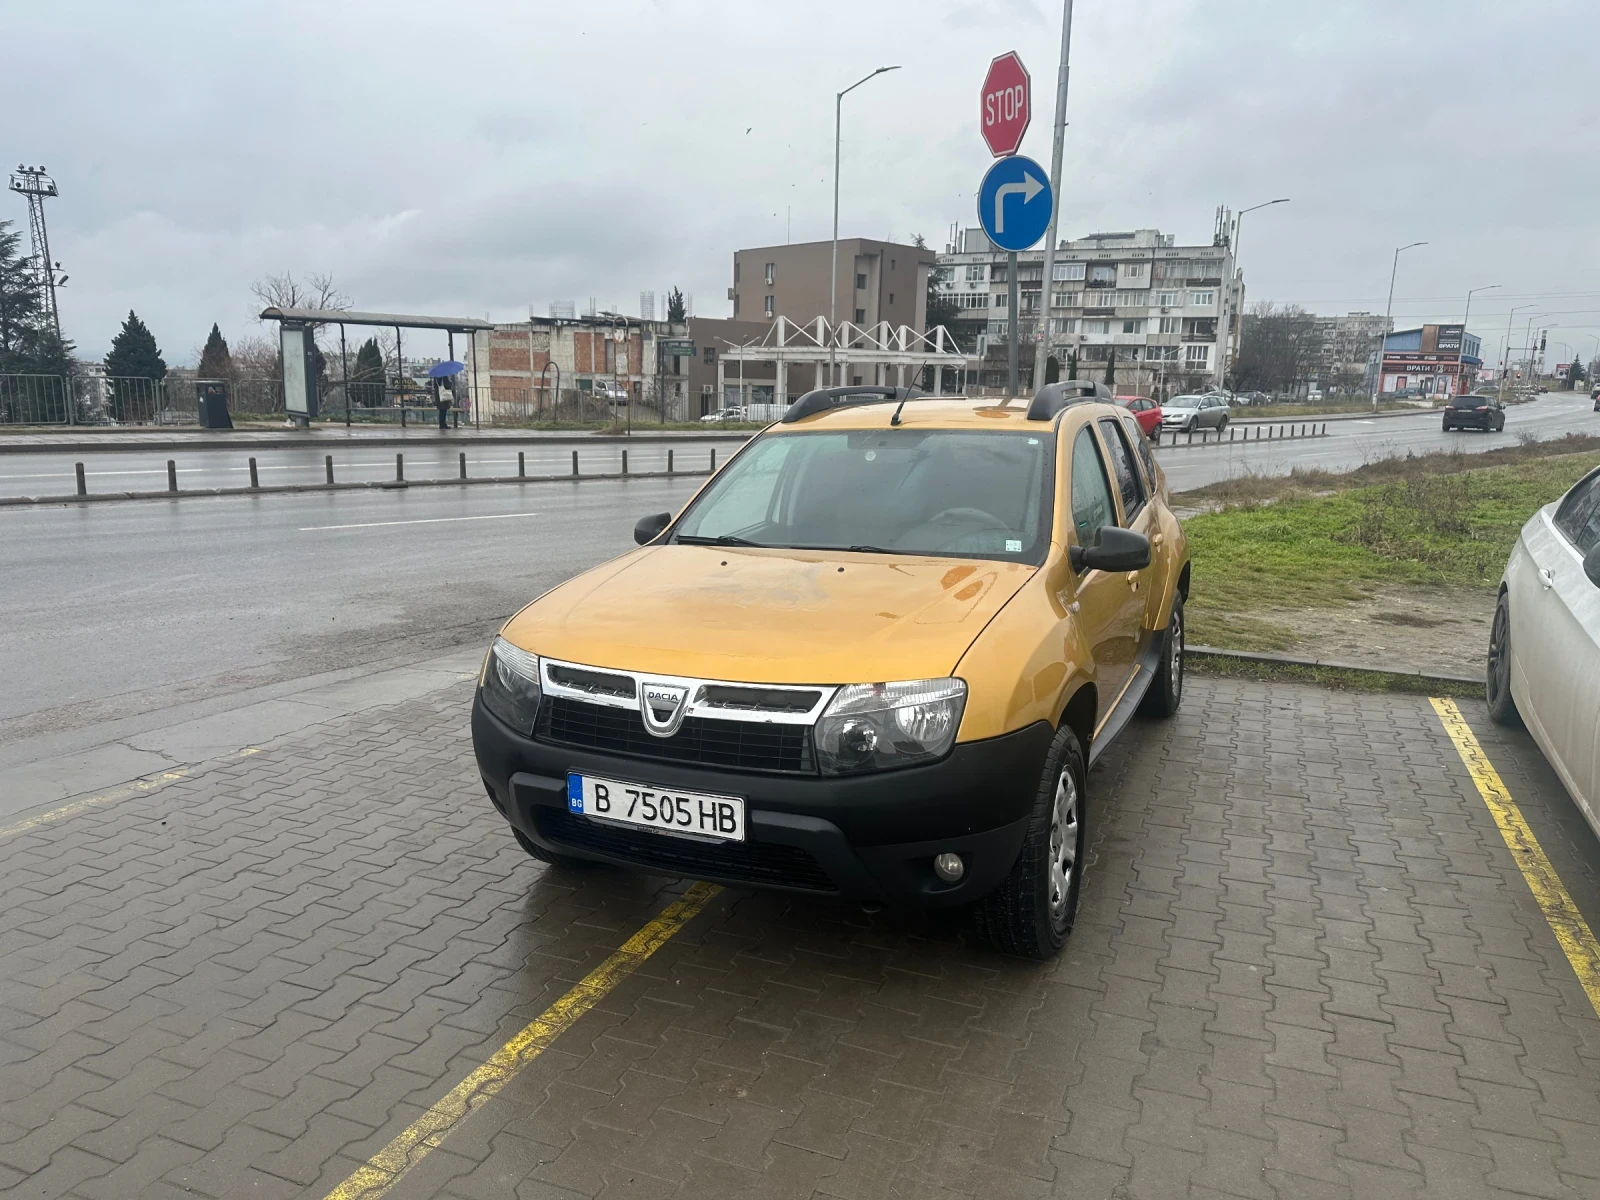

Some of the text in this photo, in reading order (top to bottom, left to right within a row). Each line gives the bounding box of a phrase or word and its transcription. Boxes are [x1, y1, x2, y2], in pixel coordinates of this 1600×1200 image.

[986, 84, 1024, 126] STOP
[648, 691, 678, 701] DACIA
[571, 797, 583, 808] BG
[595, 783, 736, 834] B 7505 HB
